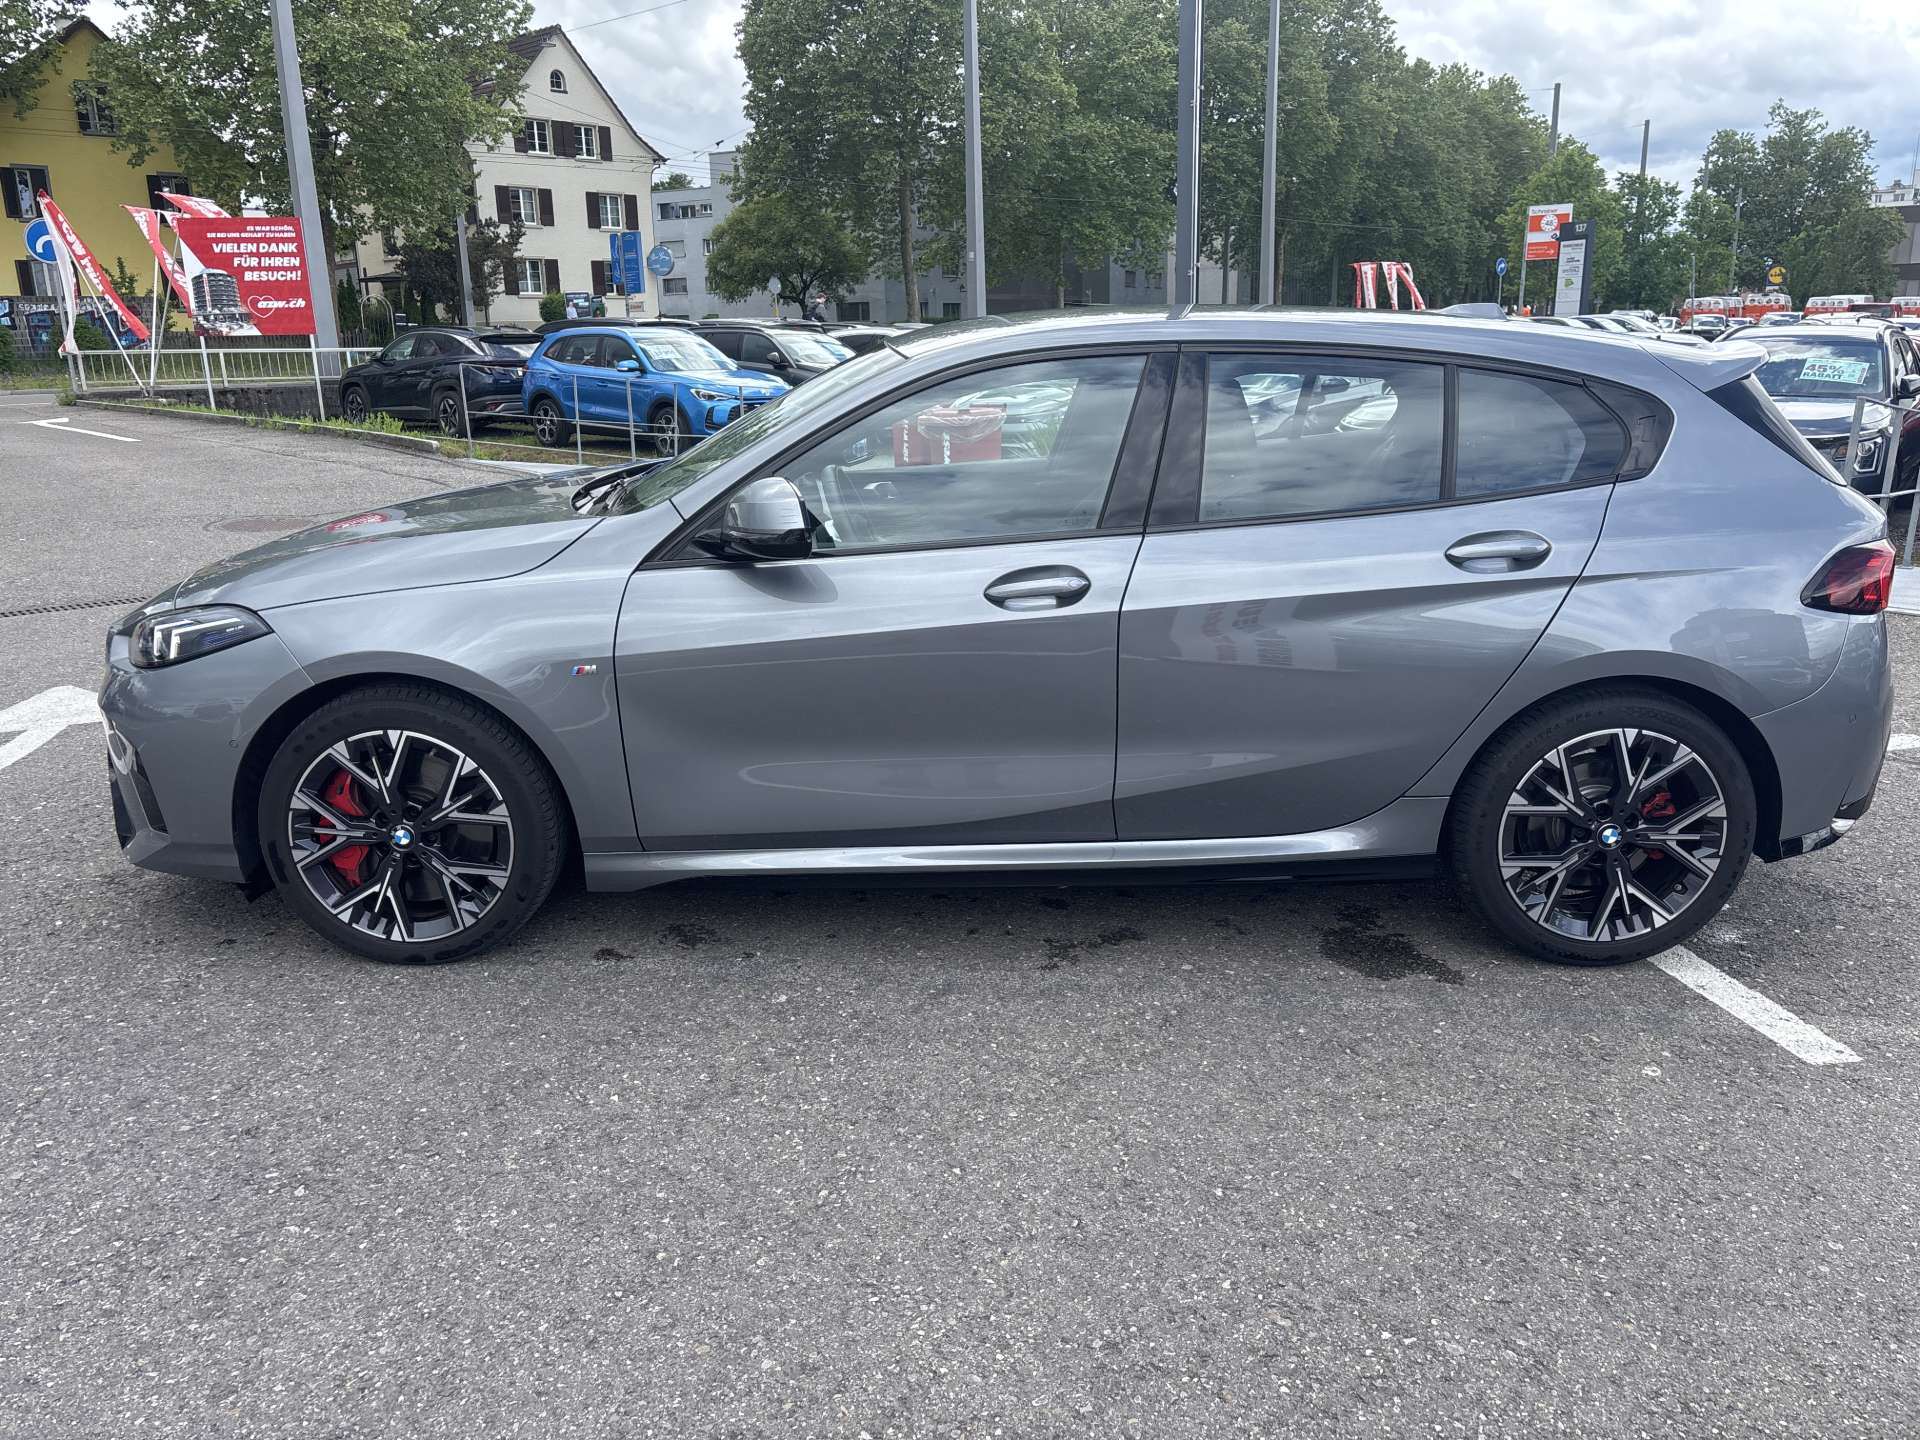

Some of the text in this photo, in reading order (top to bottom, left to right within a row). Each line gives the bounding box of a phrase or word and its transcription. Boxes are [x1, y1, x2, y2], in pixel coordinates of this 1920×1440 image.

[1575, 223, 1587, 232] 137
[212, 242, 298, 253] VIELEN DANK
[233, 254, 300, 267] FÜR IHREN
[244, 269, 302, 281] BESUCH!
[1805, 364, 1844, 374] 45%
[1803, 371, 1842, 380] RABATT
